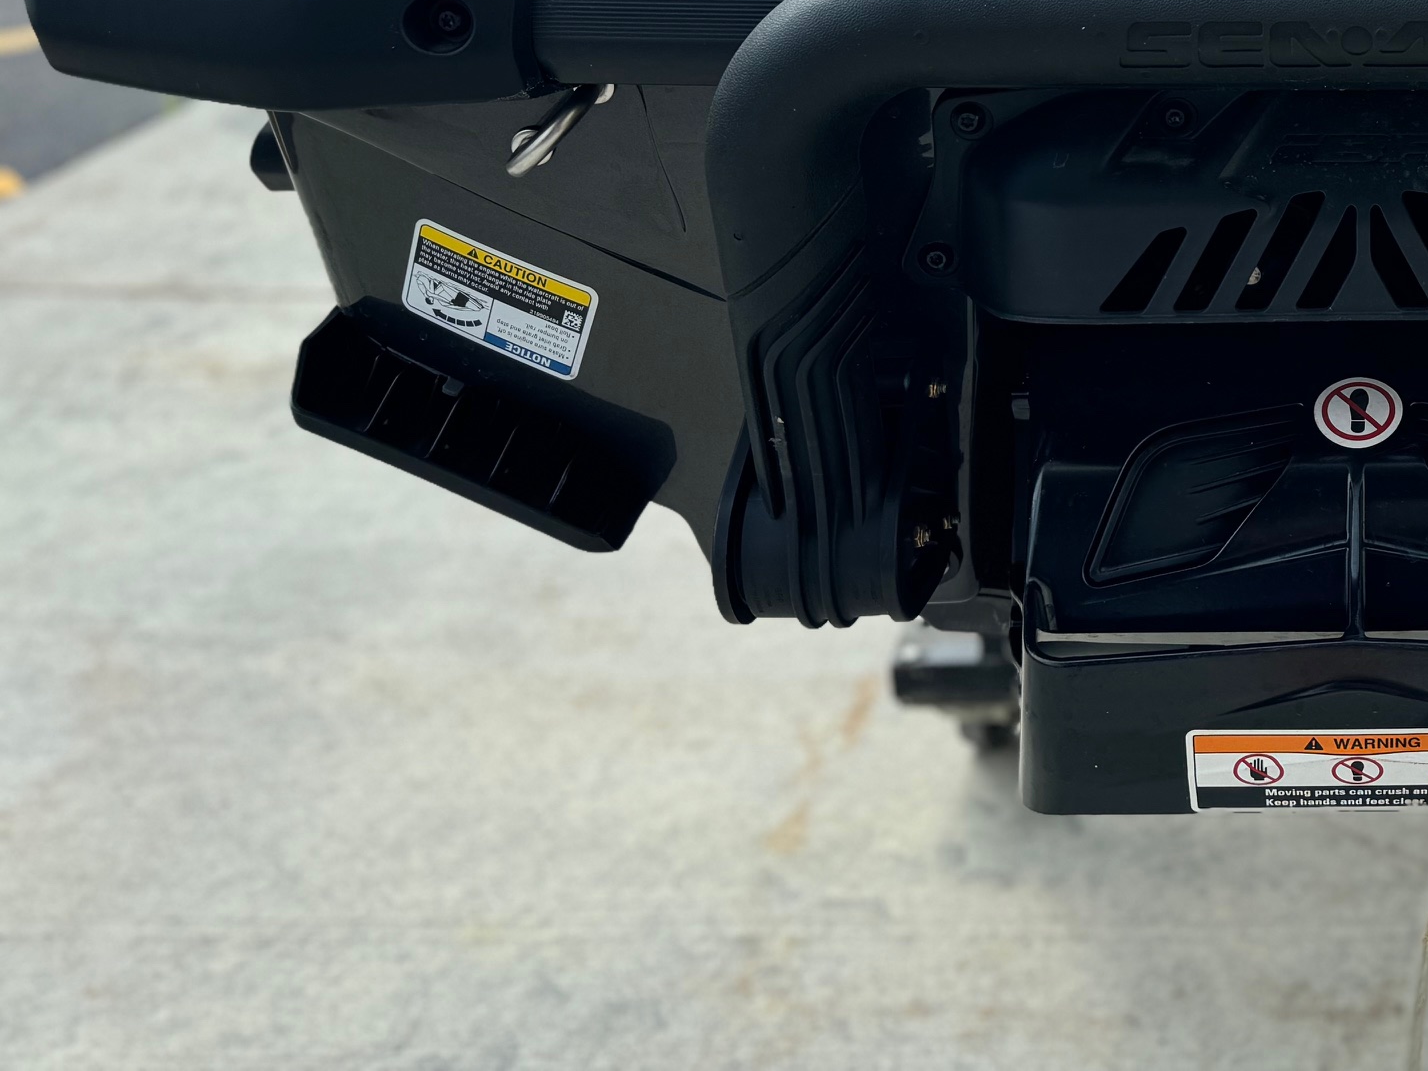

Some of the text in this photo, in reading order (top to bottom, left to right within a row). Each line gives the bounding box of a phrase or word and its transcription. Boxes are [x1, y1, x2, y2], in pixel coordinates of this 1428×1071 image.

[422, 238, 440, 251] When
[483, 254, 548, 288] CAUTION
[505, 343, 551, 367] NOTICE
[1334, 737, 1421, 750] WARNING
[1265, 788, 1311, 797] Moving
[1315, 788, 1346, 798] parts
[1349, 788, 1372, 796] can
[1375, 787, 1410, 795] crush
[1266, 798, 1297, 807] Keep
[1300, 798, 1337, 806] hands
[1340, 797, 1363, 805] and
[1366, 797, 1389, 805] feet
